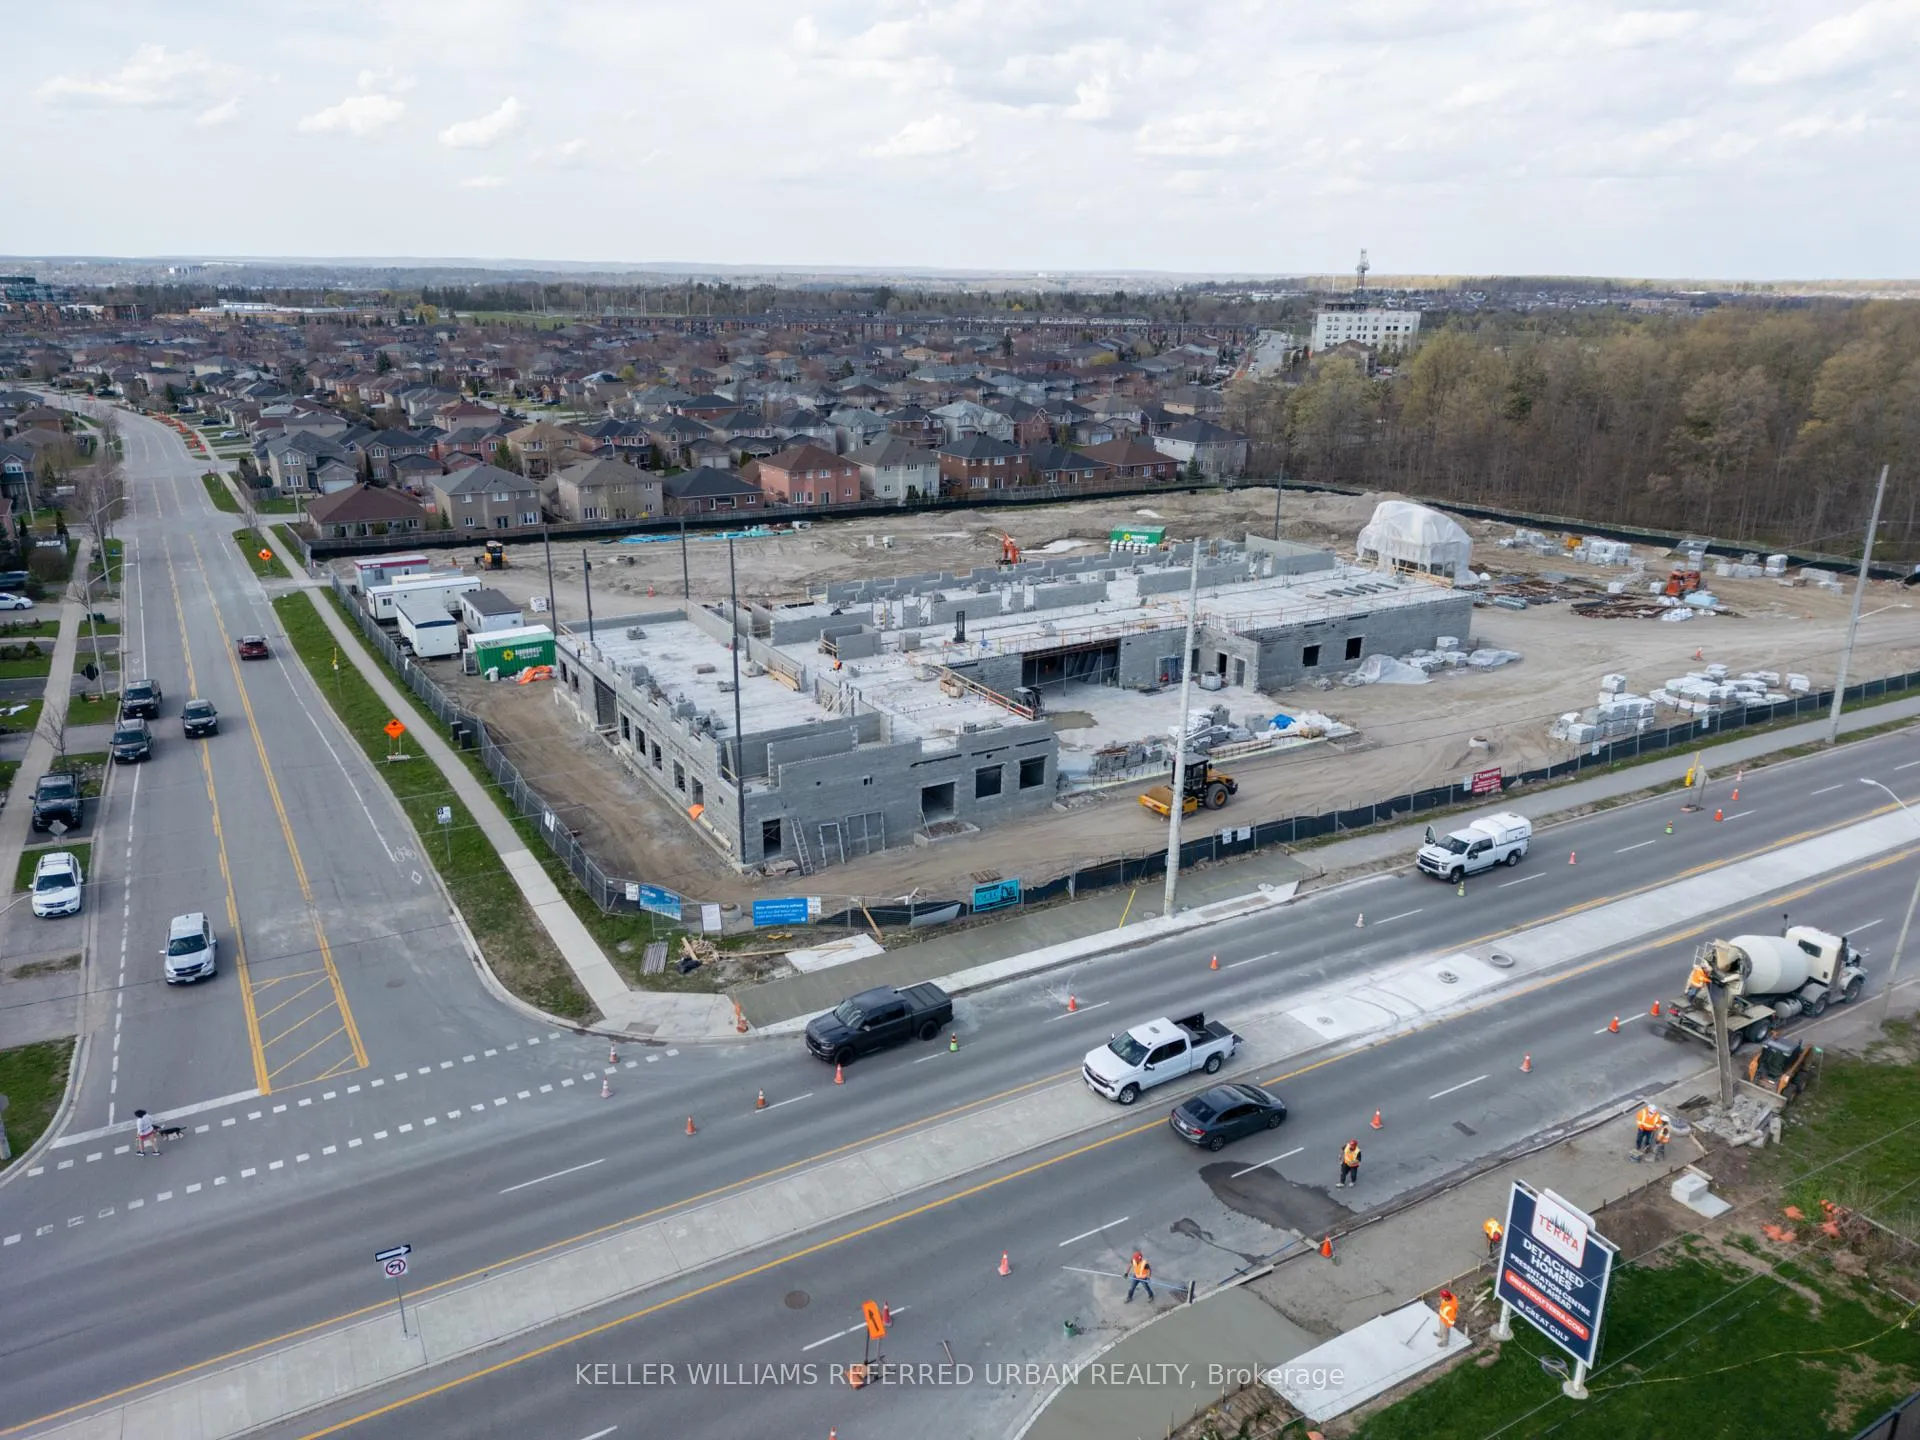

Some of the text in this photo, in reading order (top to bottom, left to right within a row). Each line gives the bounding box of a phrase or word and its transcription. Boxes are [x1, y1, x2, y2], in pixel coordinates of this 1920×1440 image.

[1539, 1214, 1579, 1252] TERRA
[1522, 1237, 1584, 1289] DETACHED
[1531, 1254, 1572, 1292] HOMES
[1510, 1252, 1591, 1317] PRESENTATION CENTRE
[1546, 1286, 1572, 1311] AHEAD
[1525, 1304, 1570, 1343] GREAT GULF
